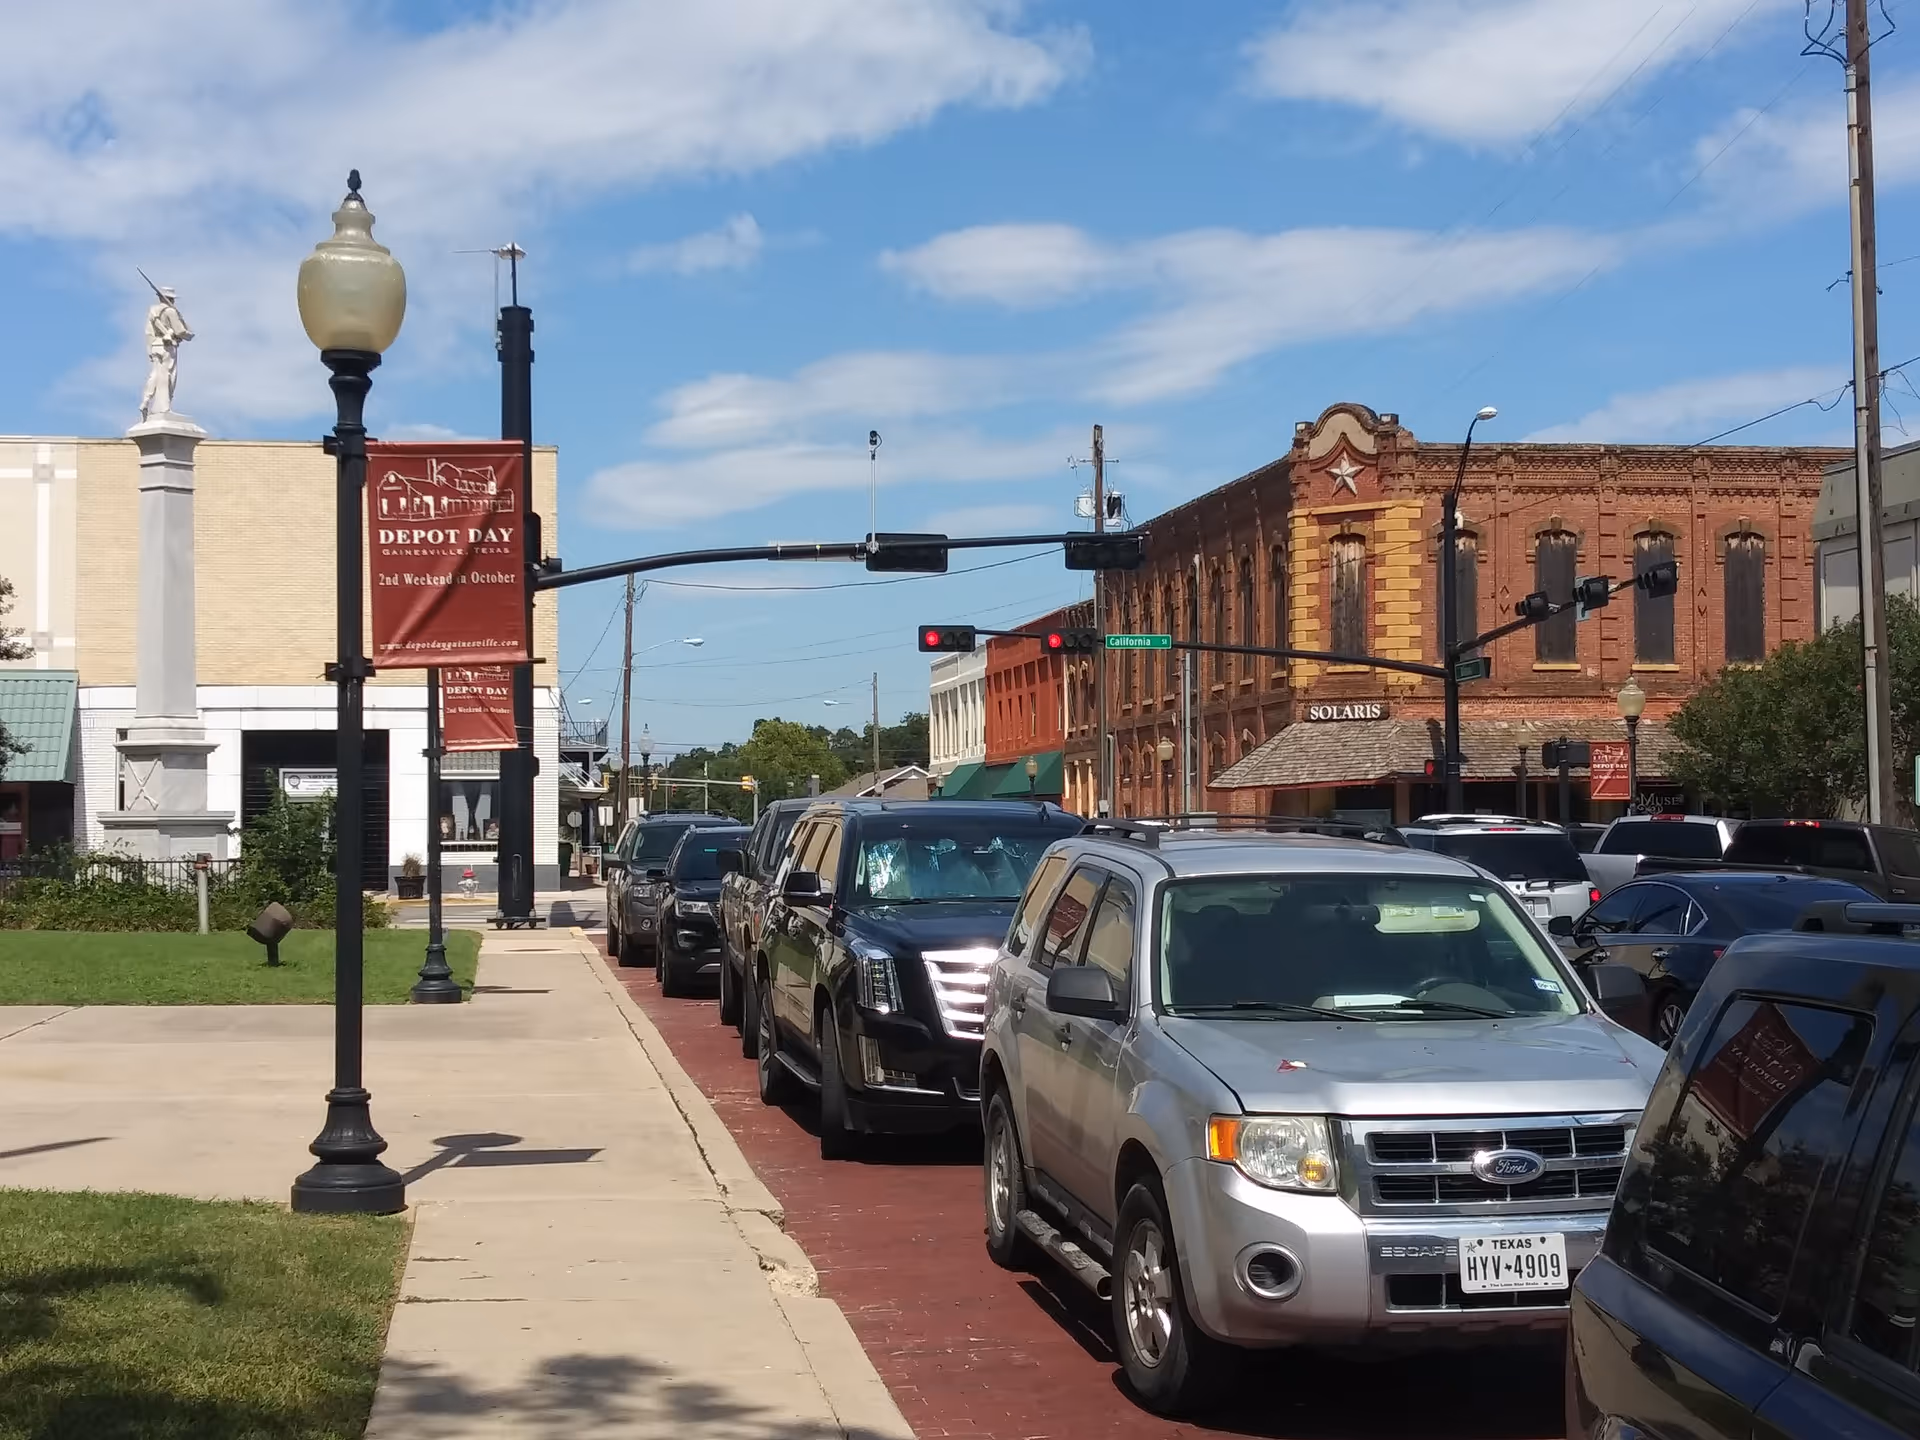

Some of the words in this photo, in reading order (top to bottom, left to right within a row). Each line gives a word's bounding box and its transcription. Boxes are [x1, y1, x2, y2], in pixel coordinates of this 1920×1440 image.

[379, 529, 460, 544] DEPOT
[468, 527, 514, 543] DAY
[379, 573, 399, 586] 2nd
[404, 572, 453, 586] Weekend
[471, 571, 516, 584] October
[380, 639, 519, 651] www.depotdaygainesville.com
[1109, 637, 1151, 646] California
[446, 686, 483, 694] DEPOT
[486, 687, 509, 695] DAY
[1310, 704, 1381, 720] SOLARIS
[1495, 1159, 1528, 1173] Ford
[1492, 1239, 1532, 1250] TEXAS
[1380, 1246, 1458, 1257] ESCAPE
